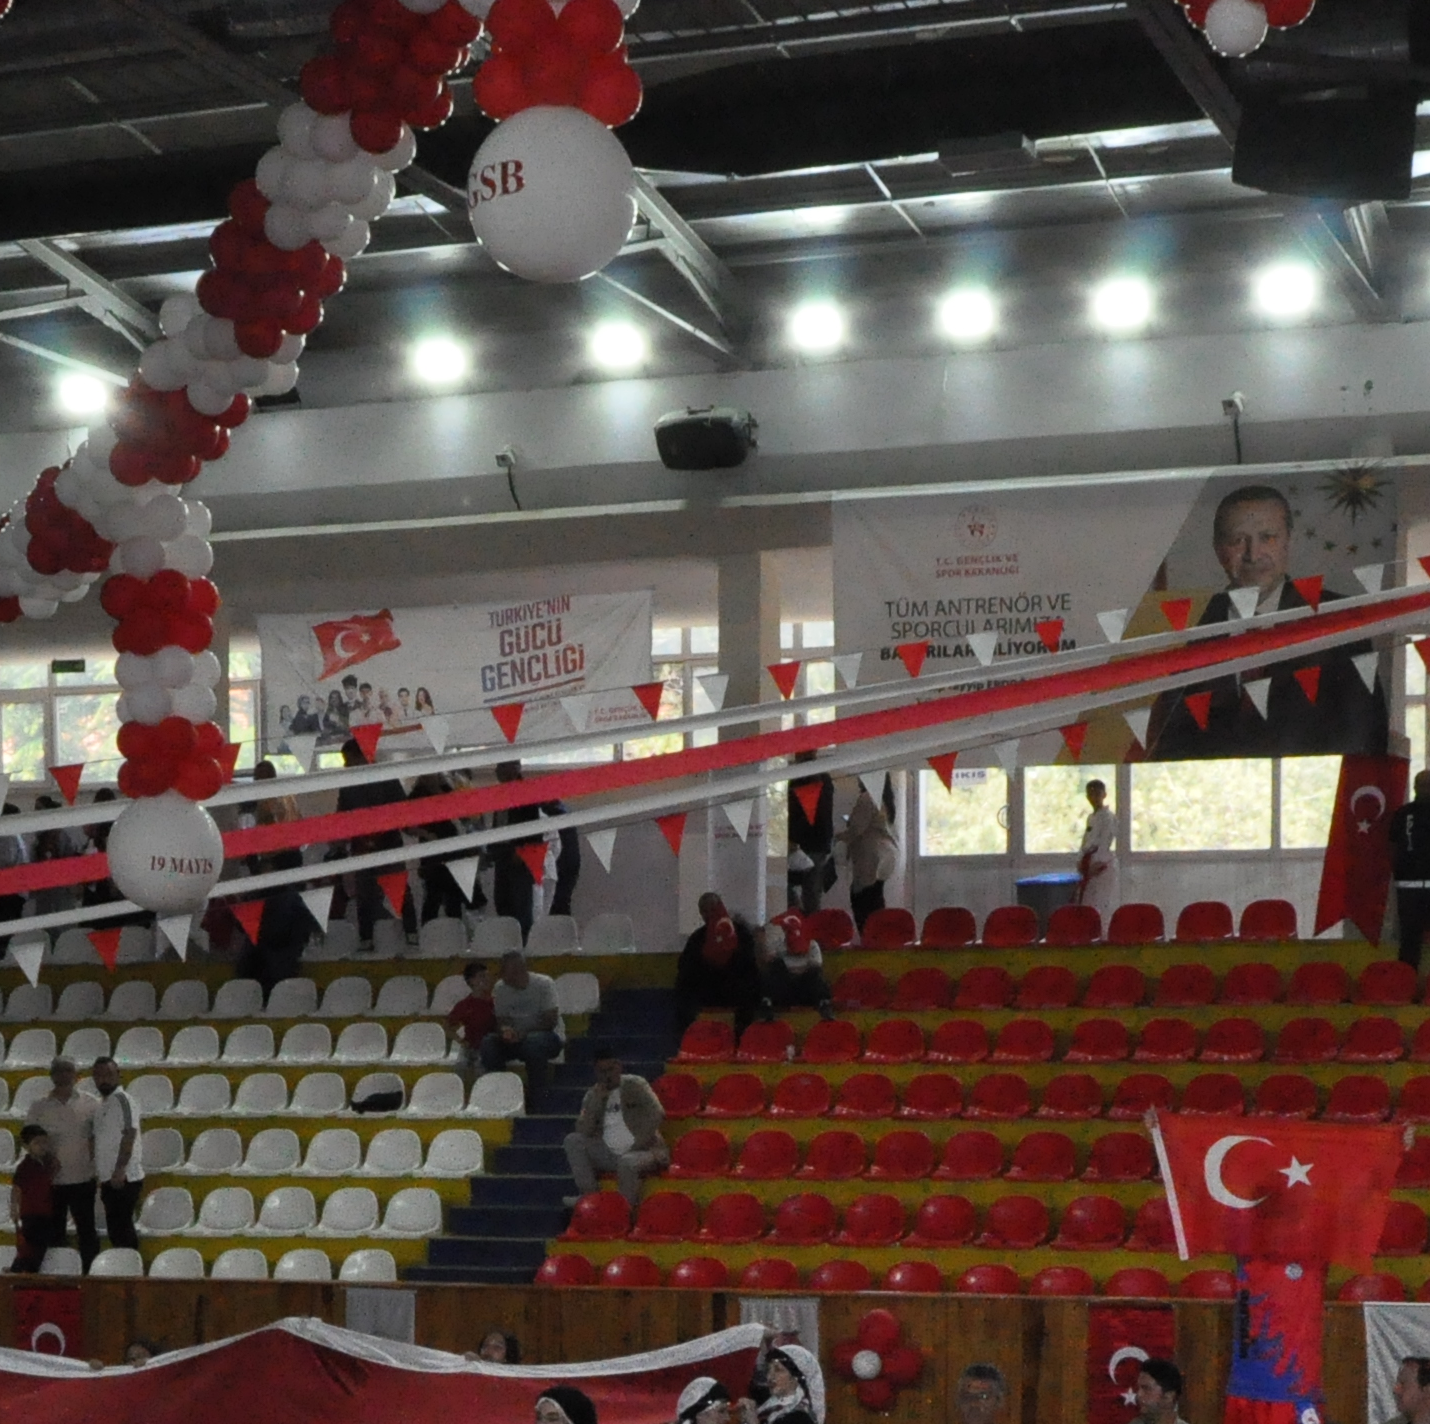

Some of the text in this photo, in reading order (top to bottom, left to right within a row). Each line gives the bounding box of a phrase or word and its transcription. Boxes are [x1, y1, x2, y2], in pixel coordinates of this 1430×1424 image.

[885, 593, 1072, 618] TÜM ANTRENÖR VE
[499, 618, 563, 658] GÜCÜ
[891, 616, 1065, 640] SPORCULARIMI
[880, 643, 976, 661] BARILAR
[151, 855, 214, 874] 19 MAYIS
